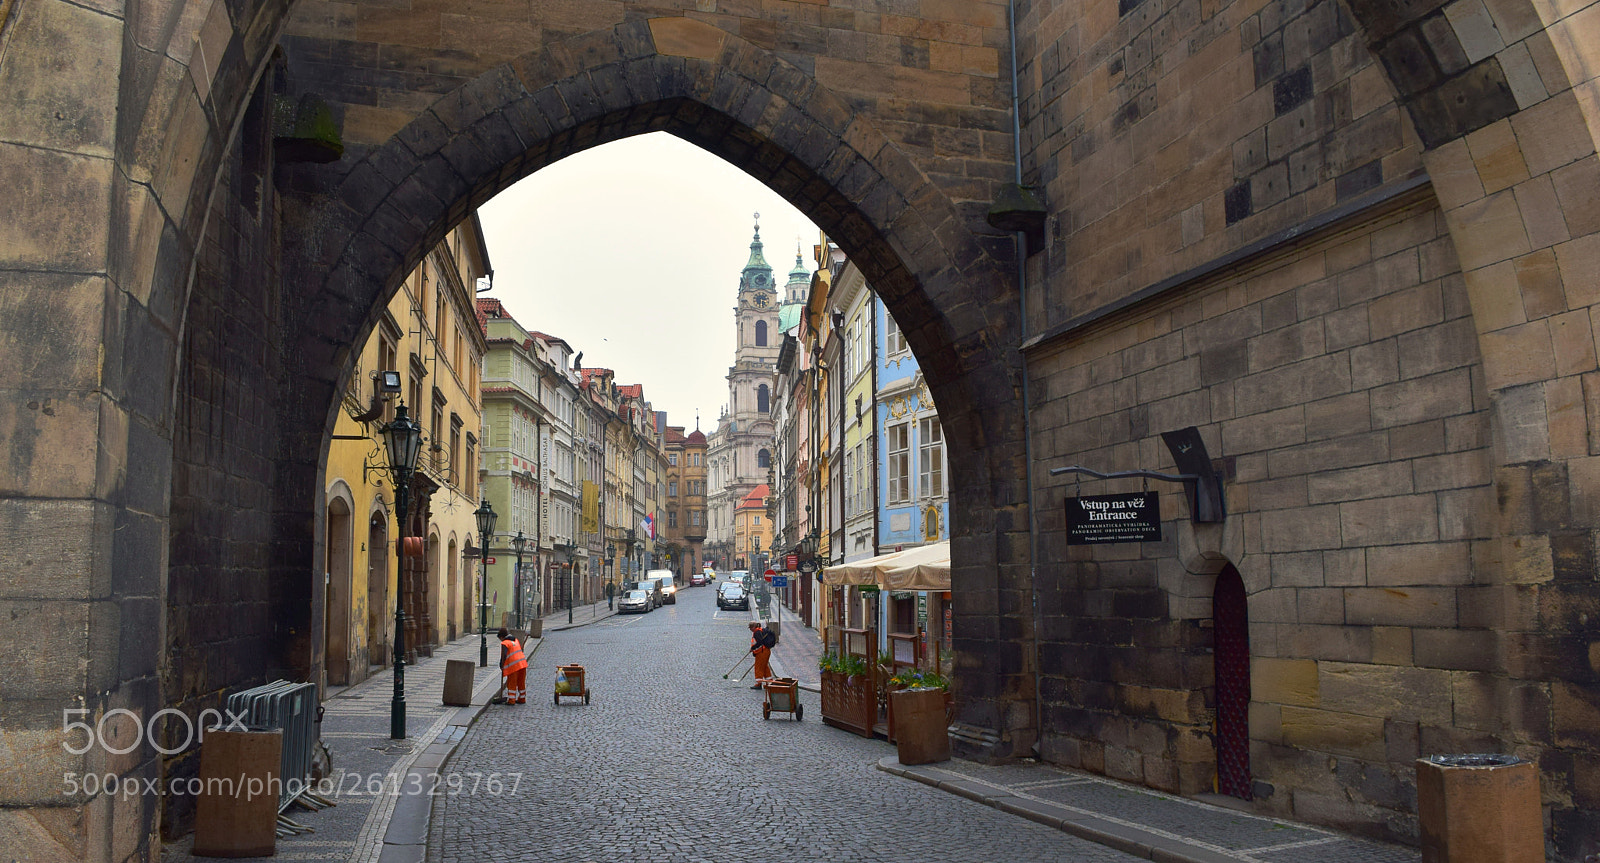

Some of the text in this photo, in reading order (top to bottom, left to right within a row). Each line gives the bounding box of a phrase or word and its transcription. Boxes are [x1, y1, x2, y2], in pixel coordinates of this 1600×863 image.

[1080, 498, 1145, 511] Vstup na věž
[1089, 511, 1137, 520] Entrance
